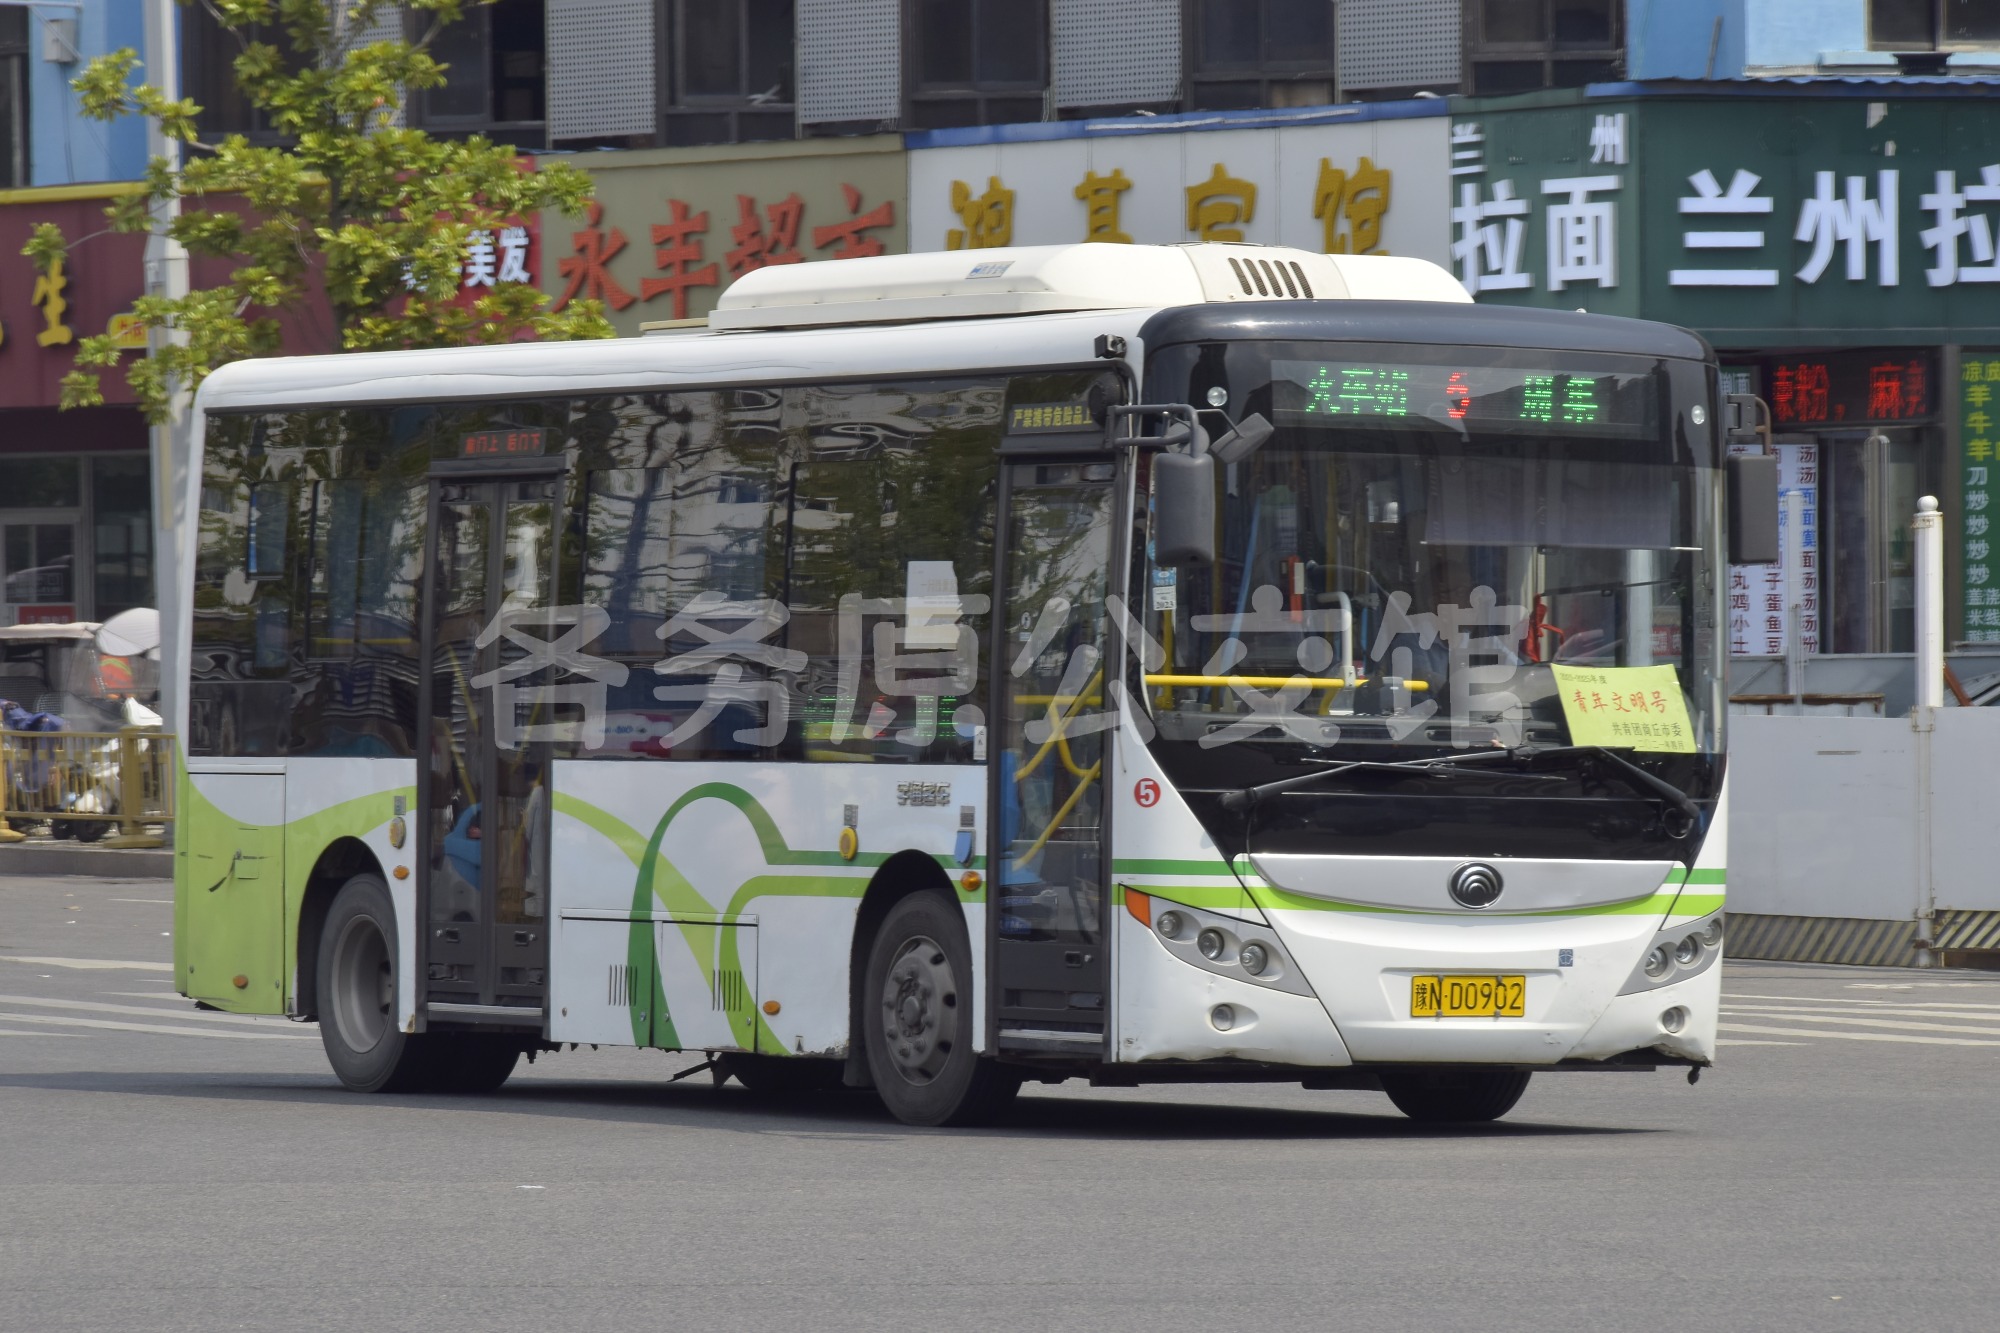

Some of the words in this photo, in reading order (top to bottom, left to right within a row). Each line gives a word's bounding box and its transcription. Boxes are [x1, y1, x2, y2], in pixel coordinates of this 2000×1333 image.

[1450, 174, 1623, 294] 拉面
[551, 182, 893, 320] 永丰超市
[1573, 689, 1668, 714] 青年文明号
[1612, 722, 1682, 737] 共青团商丘市委
[1139, 780, 1155, 804] 5
